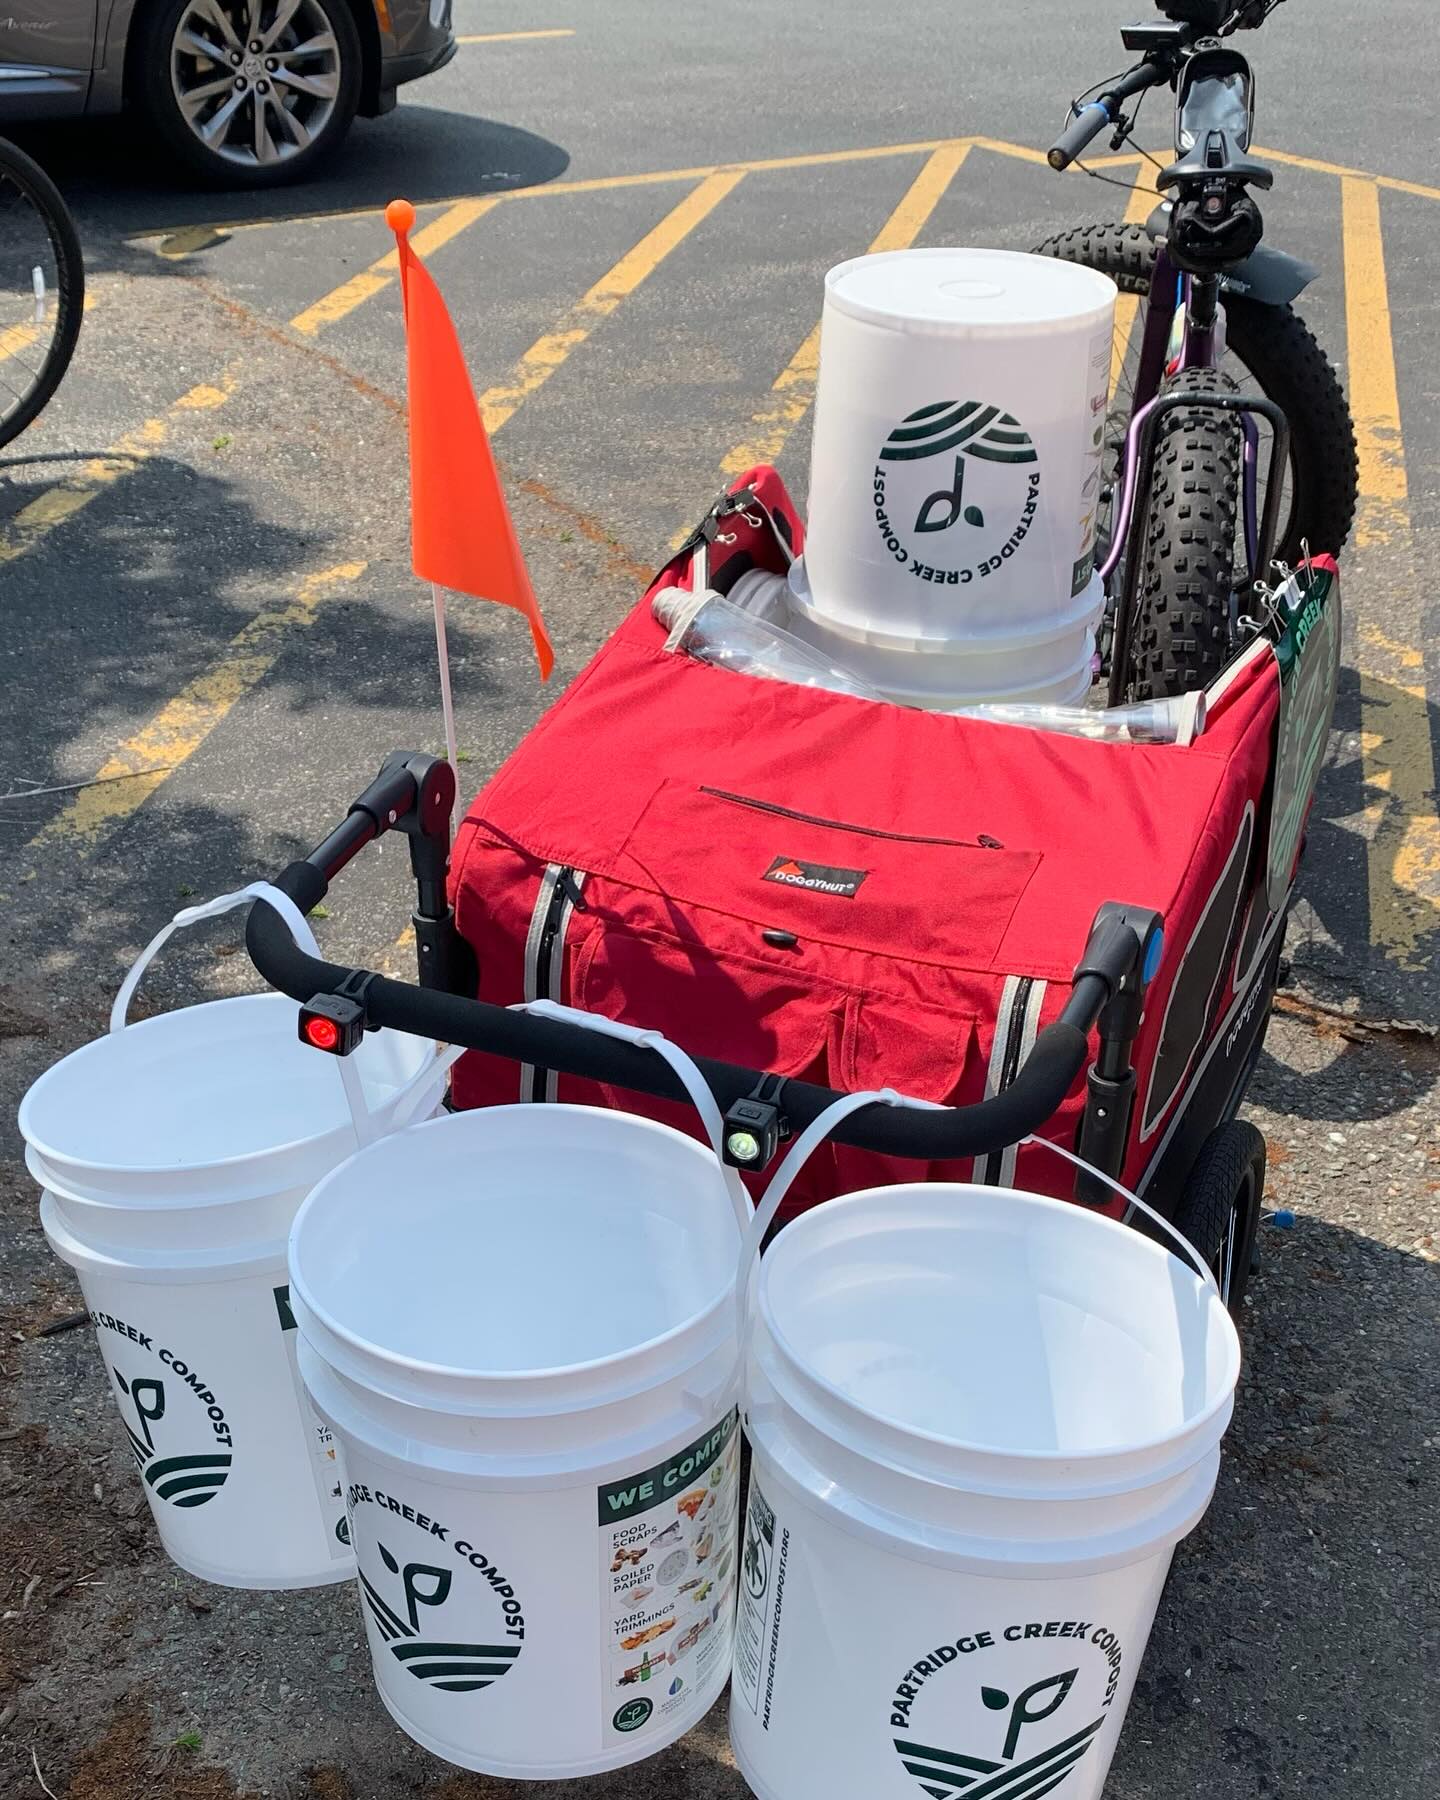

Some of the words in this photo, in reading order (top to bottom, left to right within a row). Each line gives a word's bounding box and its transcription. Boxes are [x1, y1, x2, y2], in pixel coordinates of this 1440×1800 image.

[873, 466, 908, 563] COMPOST
[977, 472, 1041, 577] PARTRIDGE
[909, 559, 973, 585] CREEK
[1296, 599, 1323, 652] CREEK
[98, 1312, 153, 1352] CREEK
[158, 1348, 233, 1448] COMPOST
[607, 1480, 655, 1511] WE
[613, 1522, 647, 1541] FOOD
[613, 1526, 658, 1549] SCRAPS
[375, 1490, 451, 1543] CREEK
[454, 1540, 525, 1640] COMPOST
[613, 1563, 655, 1585] SOILED
[613, 1573, 652, 1593] PAPER
[614, 1610, 646, 1627] YARD
[614, 1602, 676, 1635] TRIMMINGS
[762, 1527, 790, 1731] PARTRIDGECREEKCOMPOST.ORG
[890, 1631, 996, 1729] PARTRIDGE
[1003, 1621, 1094, 1641] CREEK
[1091, 1627, 1123, 1708] COMPOST
